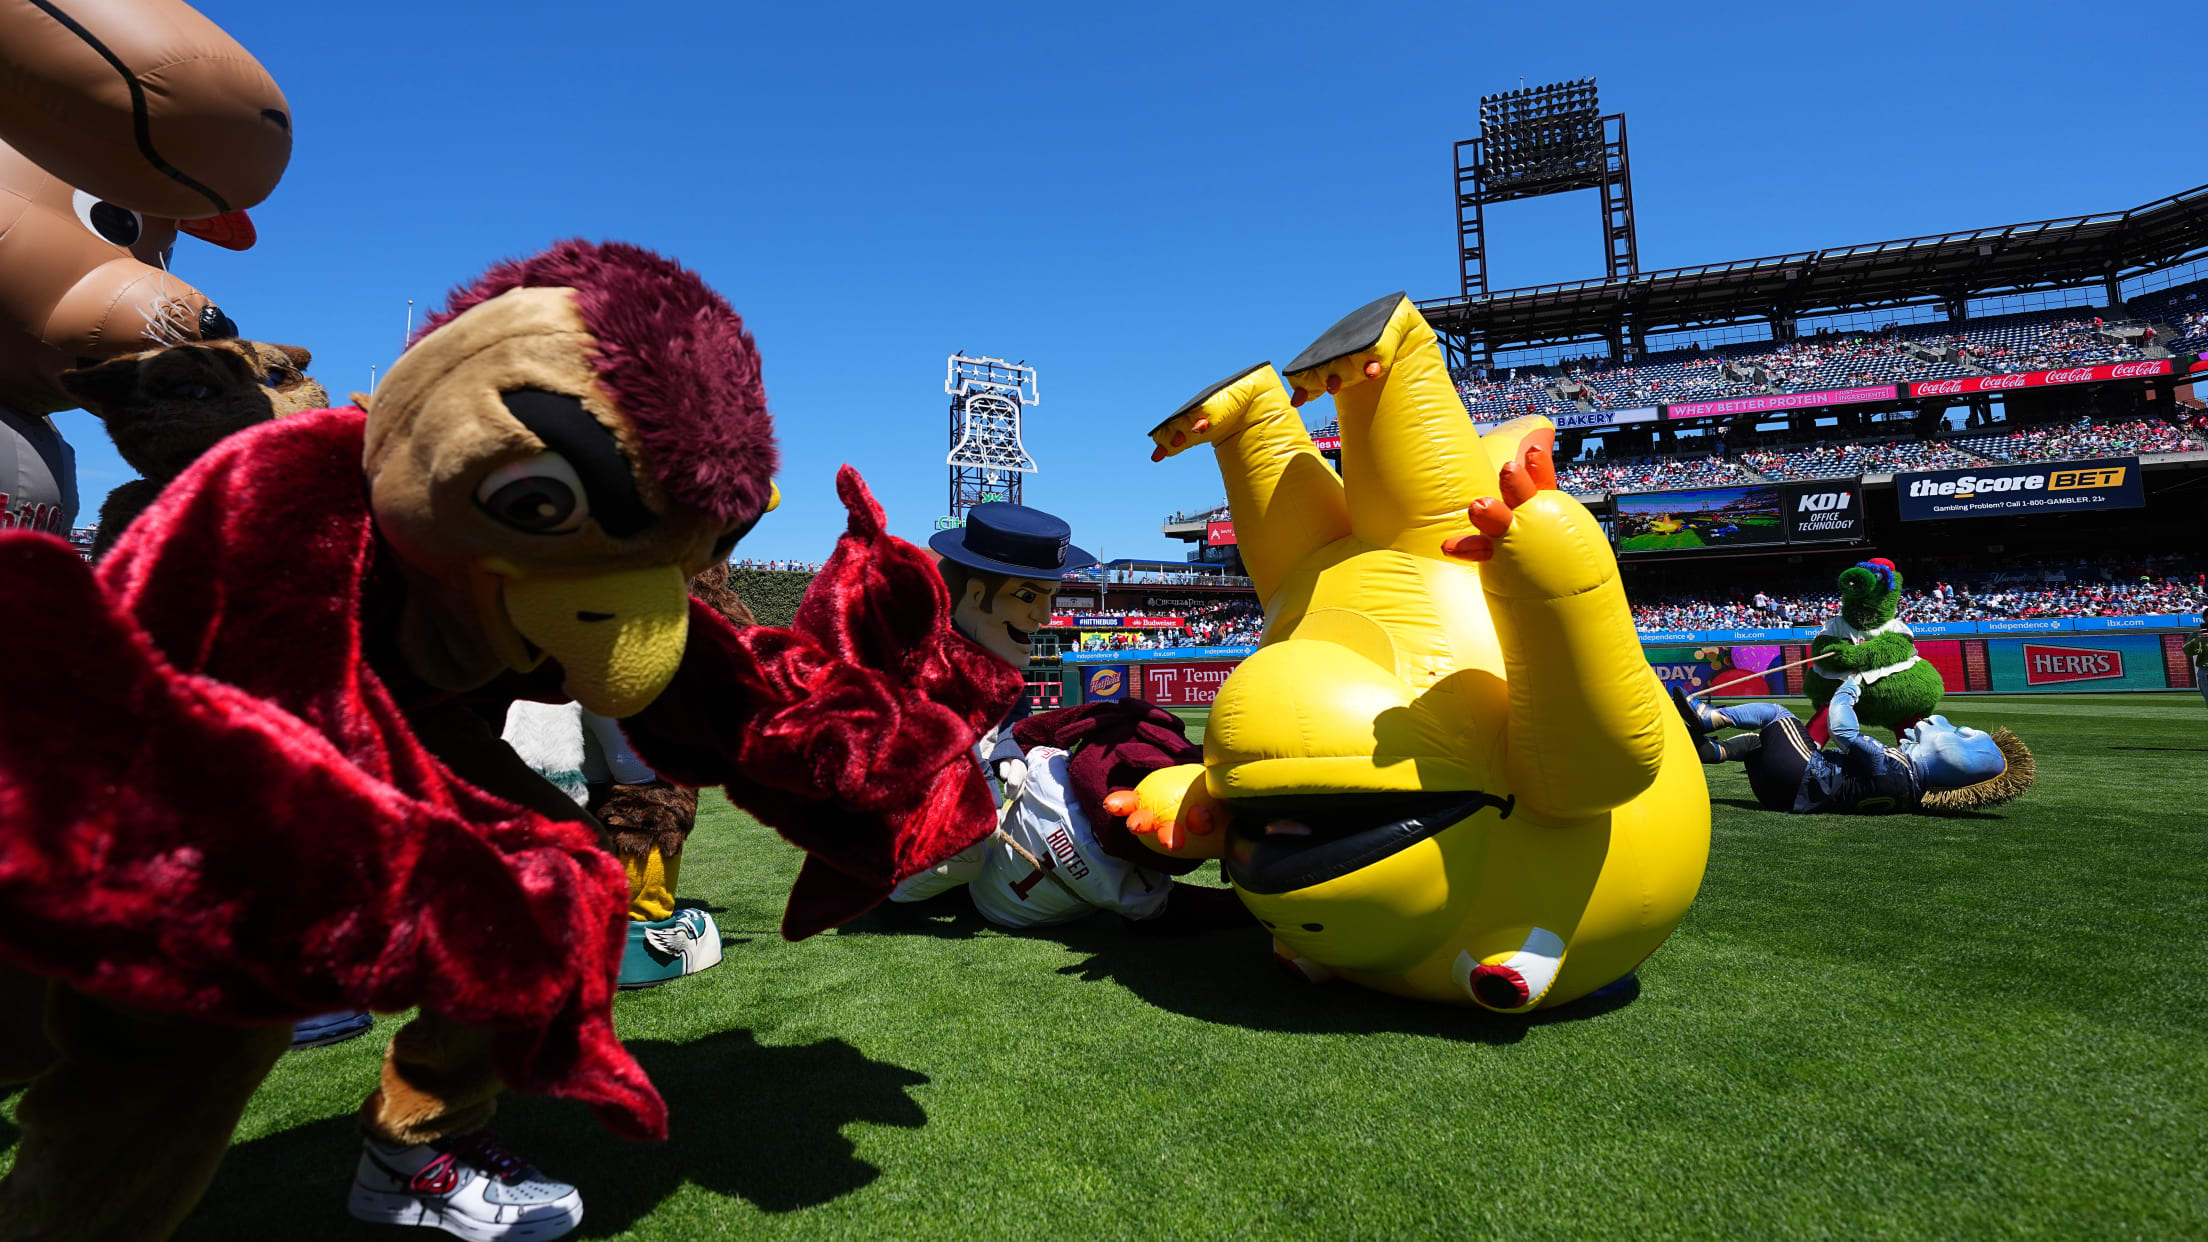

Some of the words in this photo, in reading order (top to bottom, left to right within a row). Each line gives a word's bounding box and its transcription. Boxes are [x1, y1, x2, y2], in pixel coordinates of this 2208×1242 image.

[2045, 367, 2094, 384] Coca-Cola
[2111, 360, 2161, 377] Coca-Cola
[1918, 379, 1962, 396] Coca-Cola
[1980, 373, 2027, 390] Coca-Cola
[1674, 404, 1713, 417] WHEY
[1717, 398, 1766, 412] BETTER
[1769, 393, 1828, 408] PROTEIN
[1557, 412, 1615, 427] BAKERY
[1910, 475, 2045, 498] theScore
[2055, 470, 2119, 488] BET
[1798, 492, 1851, 512] KDI
[1933, 503, 1968, 512] Gambling
[1970, 501, 2004, 510] Problem?
[2006, 500, 2021, 508] Call
[938, 516, 966, 530] Citi
[1811, 512, 1840, 521] OFFICE
[1798, 520, 1854, 531] TECHNOLOGY
[1079, 618, 1118, 626] #HITTHEBUDS
[1912, 625, 1946, 633] ibx.com
[1989, 620, 2049, 630] Independence
[2107, 619, 2145, 627] ibx.com
[1734, 631, 1765, 639] ibx.com
[1076, 653, 1112, 661] Independence
[1153, 650, 1175, 658] ibx.com
[1204, 647, 1243, 656] Independence
[2034, 653, 2111, 676] HERR'S
[1089, 672, 1122, 693] Hatfield
[1047, 828, 1090, 881] HOOTER
[1008, 850, 1055, 901] 1
